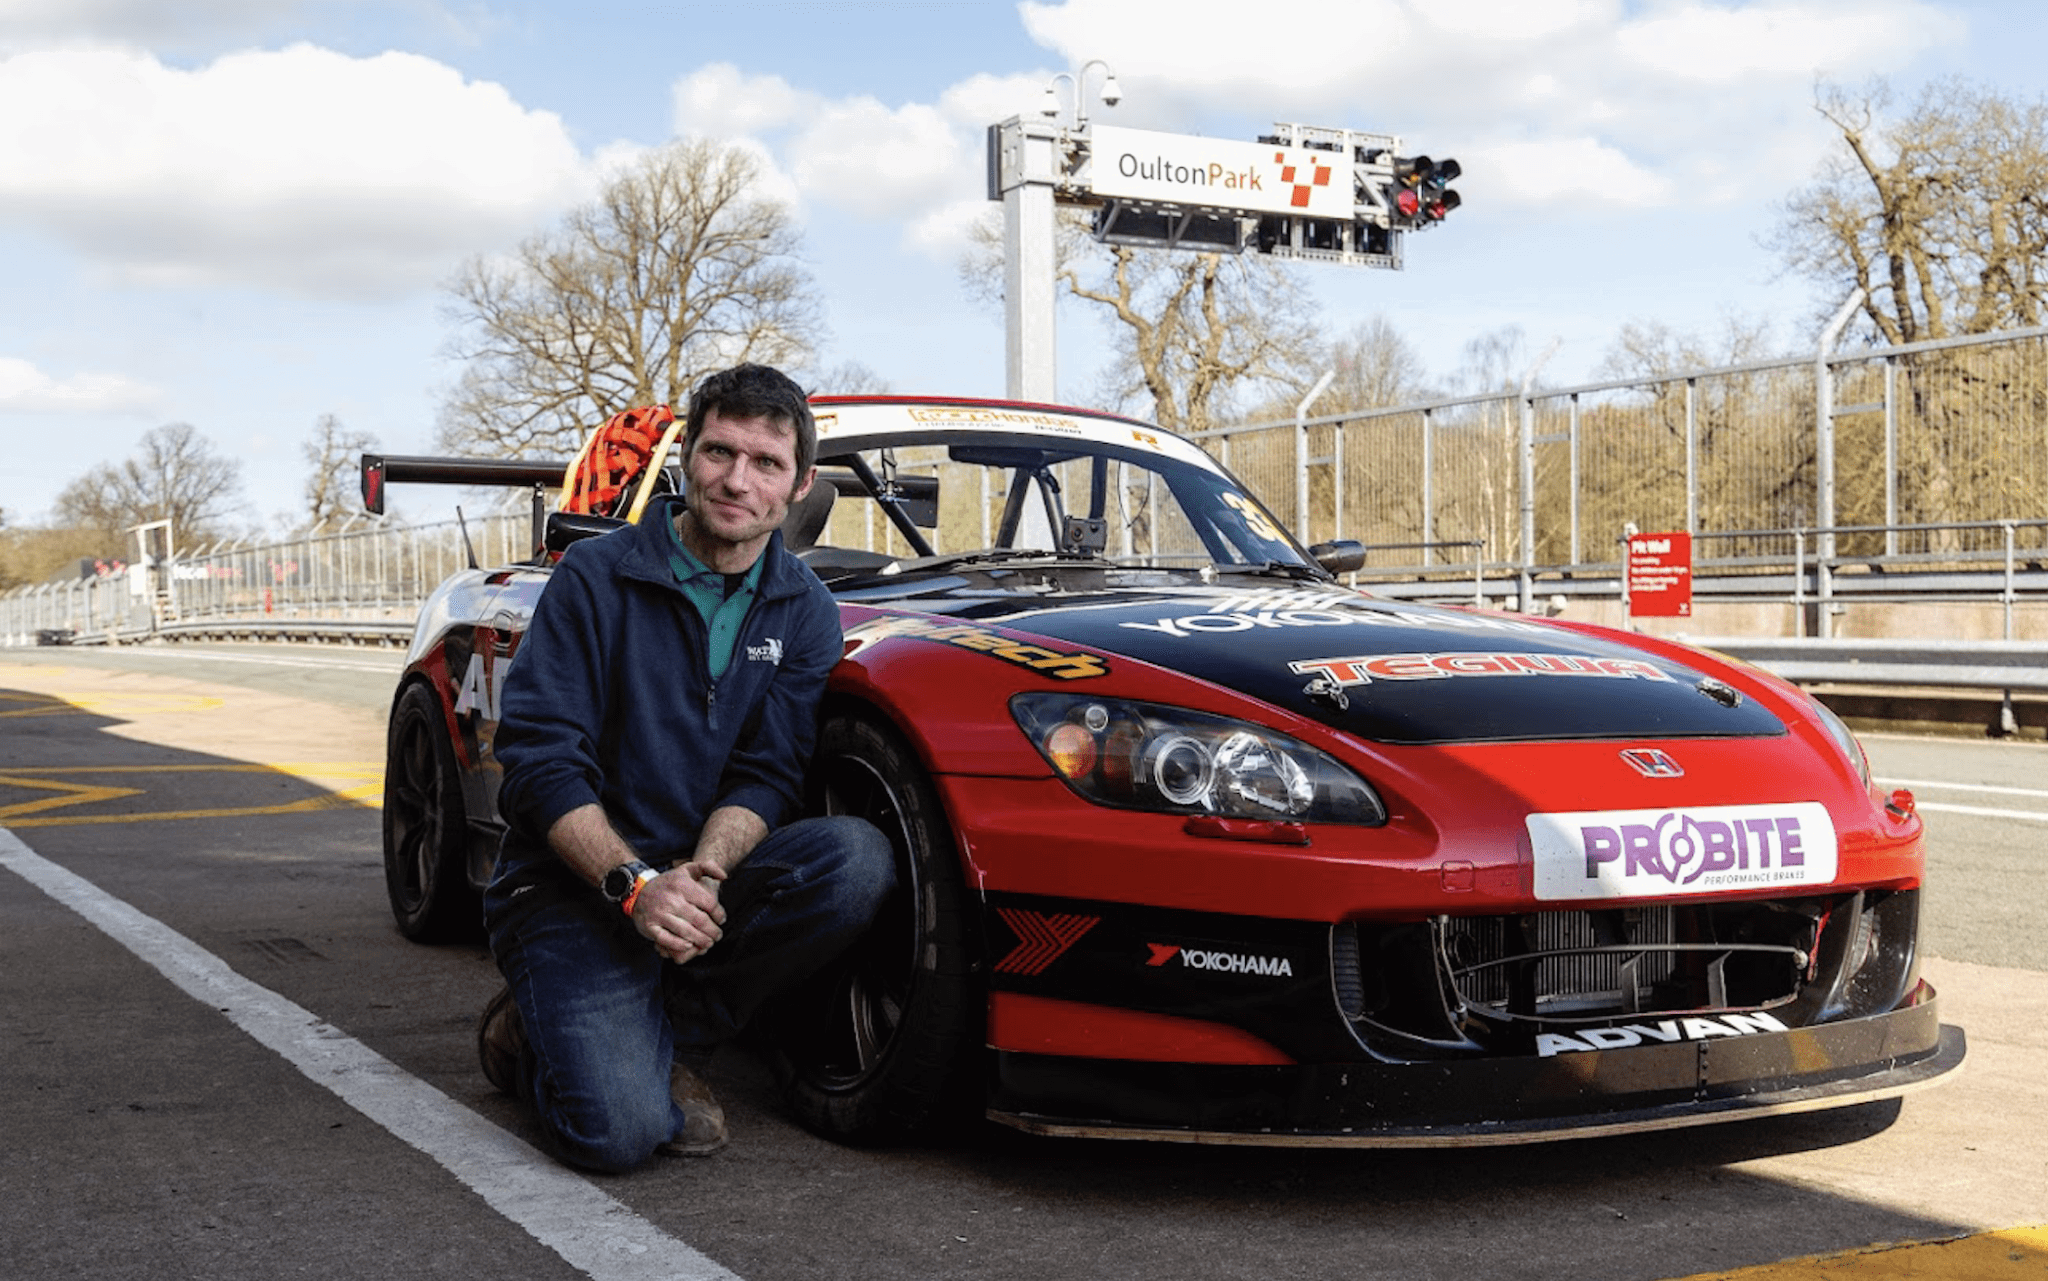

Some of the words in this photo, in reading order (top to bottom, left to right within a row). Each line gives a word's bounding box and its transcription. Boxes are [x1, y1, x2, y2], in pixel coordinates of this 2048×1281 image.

[1119, 152, 1263, 192] OultonPark
[1581, 813, 1805, 885] PROBITE
[1704, 872, 1771, 885] PERFORMANCE
[1773, 870, 1805, 881] BRAKES
[1180, 949, 1293, 977] YOKOHAMA
[1535, 1011, 1790, 1058] ADVAN
